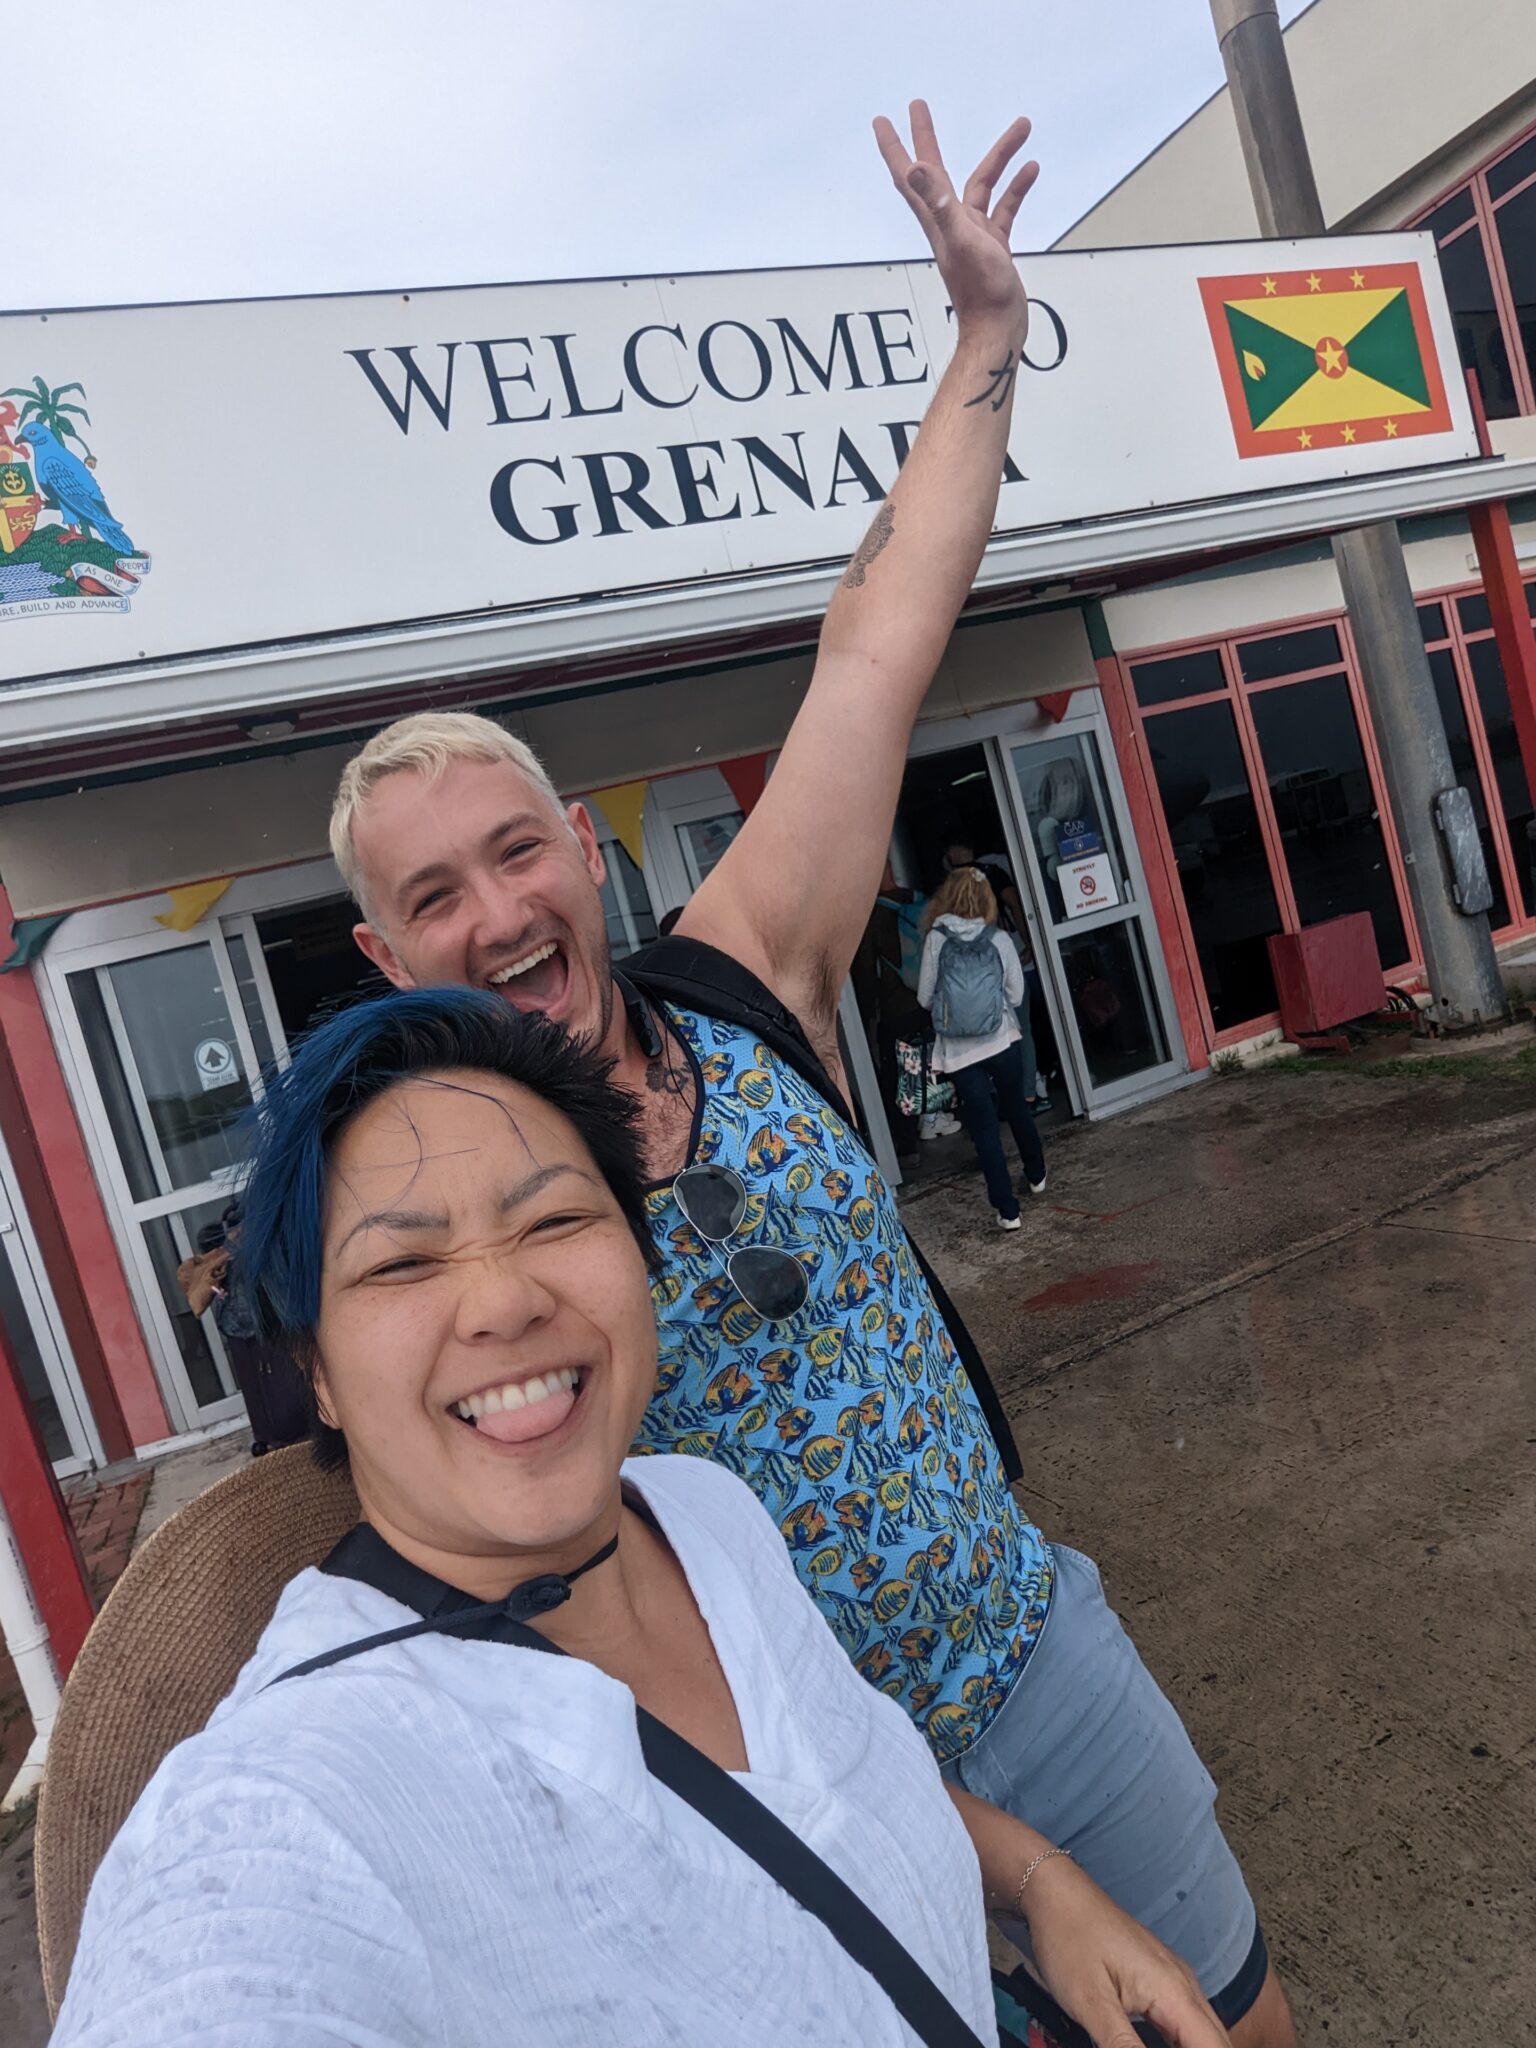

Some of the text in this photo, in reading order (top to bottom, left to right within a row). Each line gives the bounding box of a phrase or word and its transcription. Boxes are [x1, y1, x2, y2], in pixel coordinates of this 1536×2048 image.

[343, 298, 1068, 436] WELCOME O
[490, 420, 1030, 546] GRENA
[85, 566, 97, 576] AS
[104, 574, 123, 587] ONE
[20, 603, 50, 613] BUILD
[55, 601, 76, 610] AND
[81, 599, 125, 609] ADVANCE
[1072, 863, 1096, 874] STRICTLY
[1085, 896, 1108, 907] SMOKING
